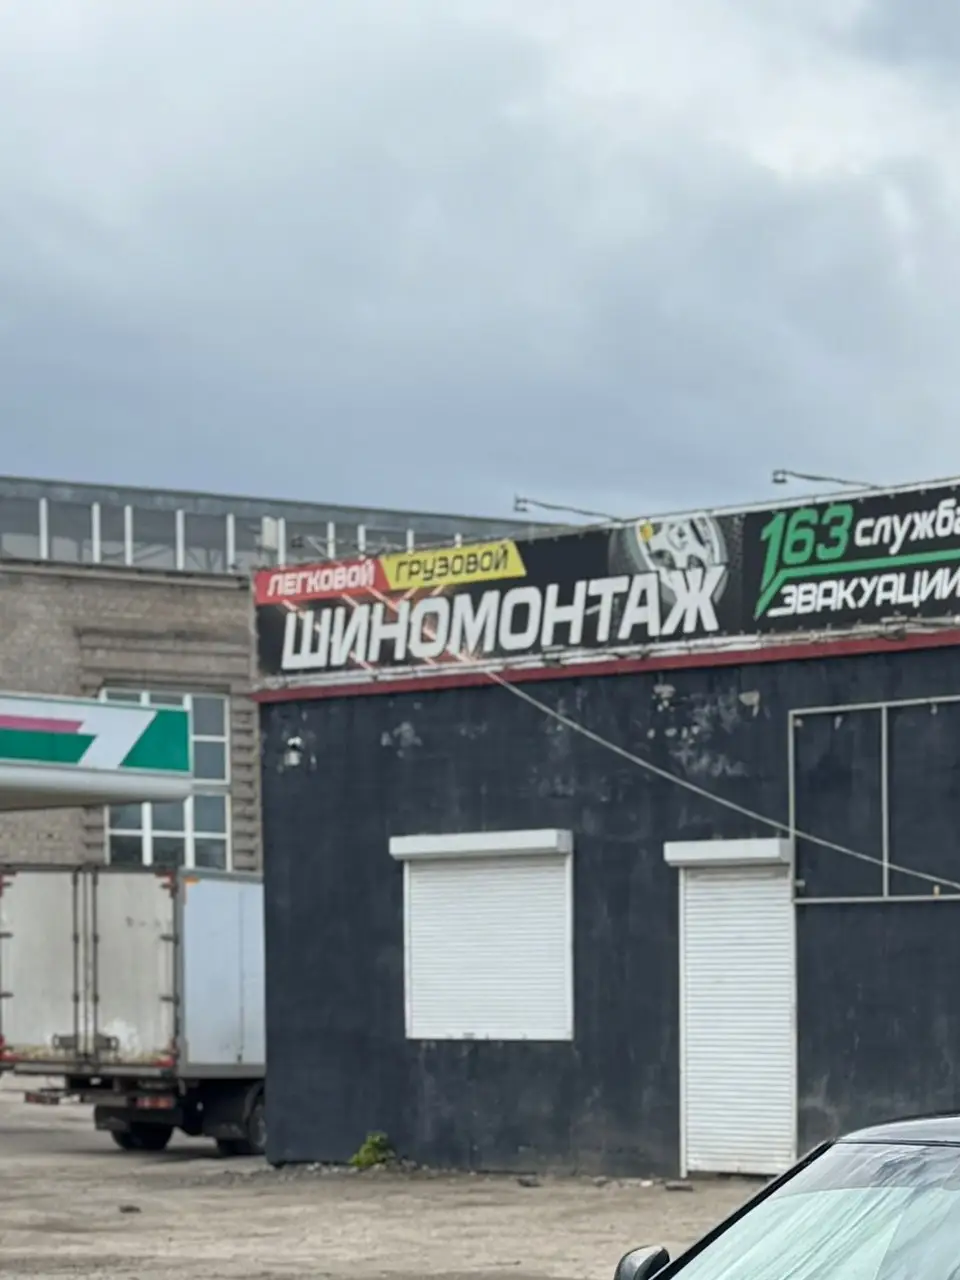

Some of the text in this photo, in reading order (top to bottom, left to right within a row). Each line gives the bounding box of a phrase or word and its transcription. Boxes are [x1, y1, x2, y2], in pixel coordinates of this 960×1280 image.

[267, 558, 376, 597] ЛЕГКОВОЙ
[395, 547, 509, 582] ГРУЗОВОЙ
[760, 504, 853, 592] 163
[281, 565, 725, 671] ШИНОМОНТАЖ
